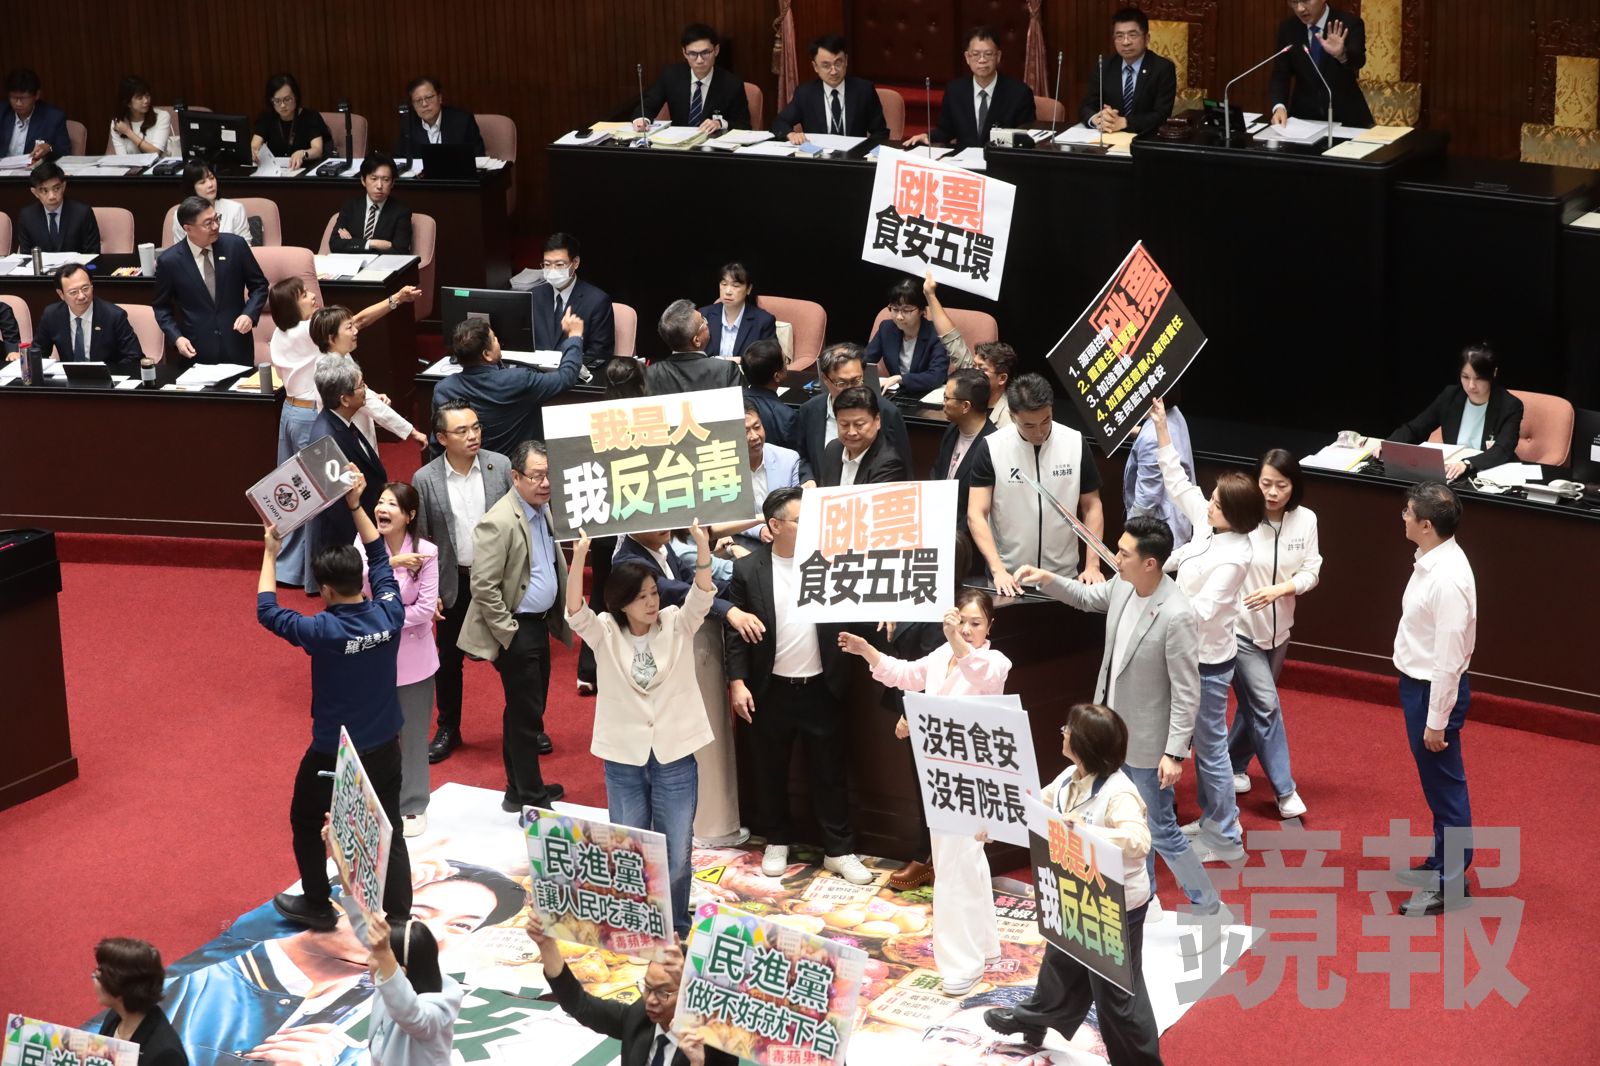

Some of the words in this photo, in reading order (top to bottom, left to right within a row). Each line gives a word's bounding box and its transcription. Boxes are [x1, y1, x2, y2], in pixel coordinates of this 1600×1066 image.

[898, 169, 982, 229] 跳票
[872, 205, 995, 283] 食安五環
[1078, 324, 1114, 369] 源頭控管
[1077, 380, 1090, 395] 2.
[1086, 394, 1100, 408] 3.
[1096, 353, 1134, 397] 加強查驗
[1103, 423, 1117, 437] 5.
[1114, 364, 1167, 426] 全民監督食安
[590, 400, 711, 454] 我是人
[1096, 408, 1108, 422] 4.
[563, 440, 742, 530] 我反台毒
[824, 490, 919, 554] 跳票
[796, 547, 939, 607] 食安五環
[918, 713, 1020, 771] 沒有食安
[926, 768, 1028, 827] 沒有院長
[544, 836, 647, 896] 民進黨
[1047, 819, 1107, 893] 我是人
[536, 881, 665, 939] 讓人民吃毒油
[1038, 866, 1125, 968] 我反台毒
[708, 932, 834, 1014] 民進黨
[687, 979, 840, 1059] 做不好就下台
[772, 1049, 817, 1065] 毒蘋果
